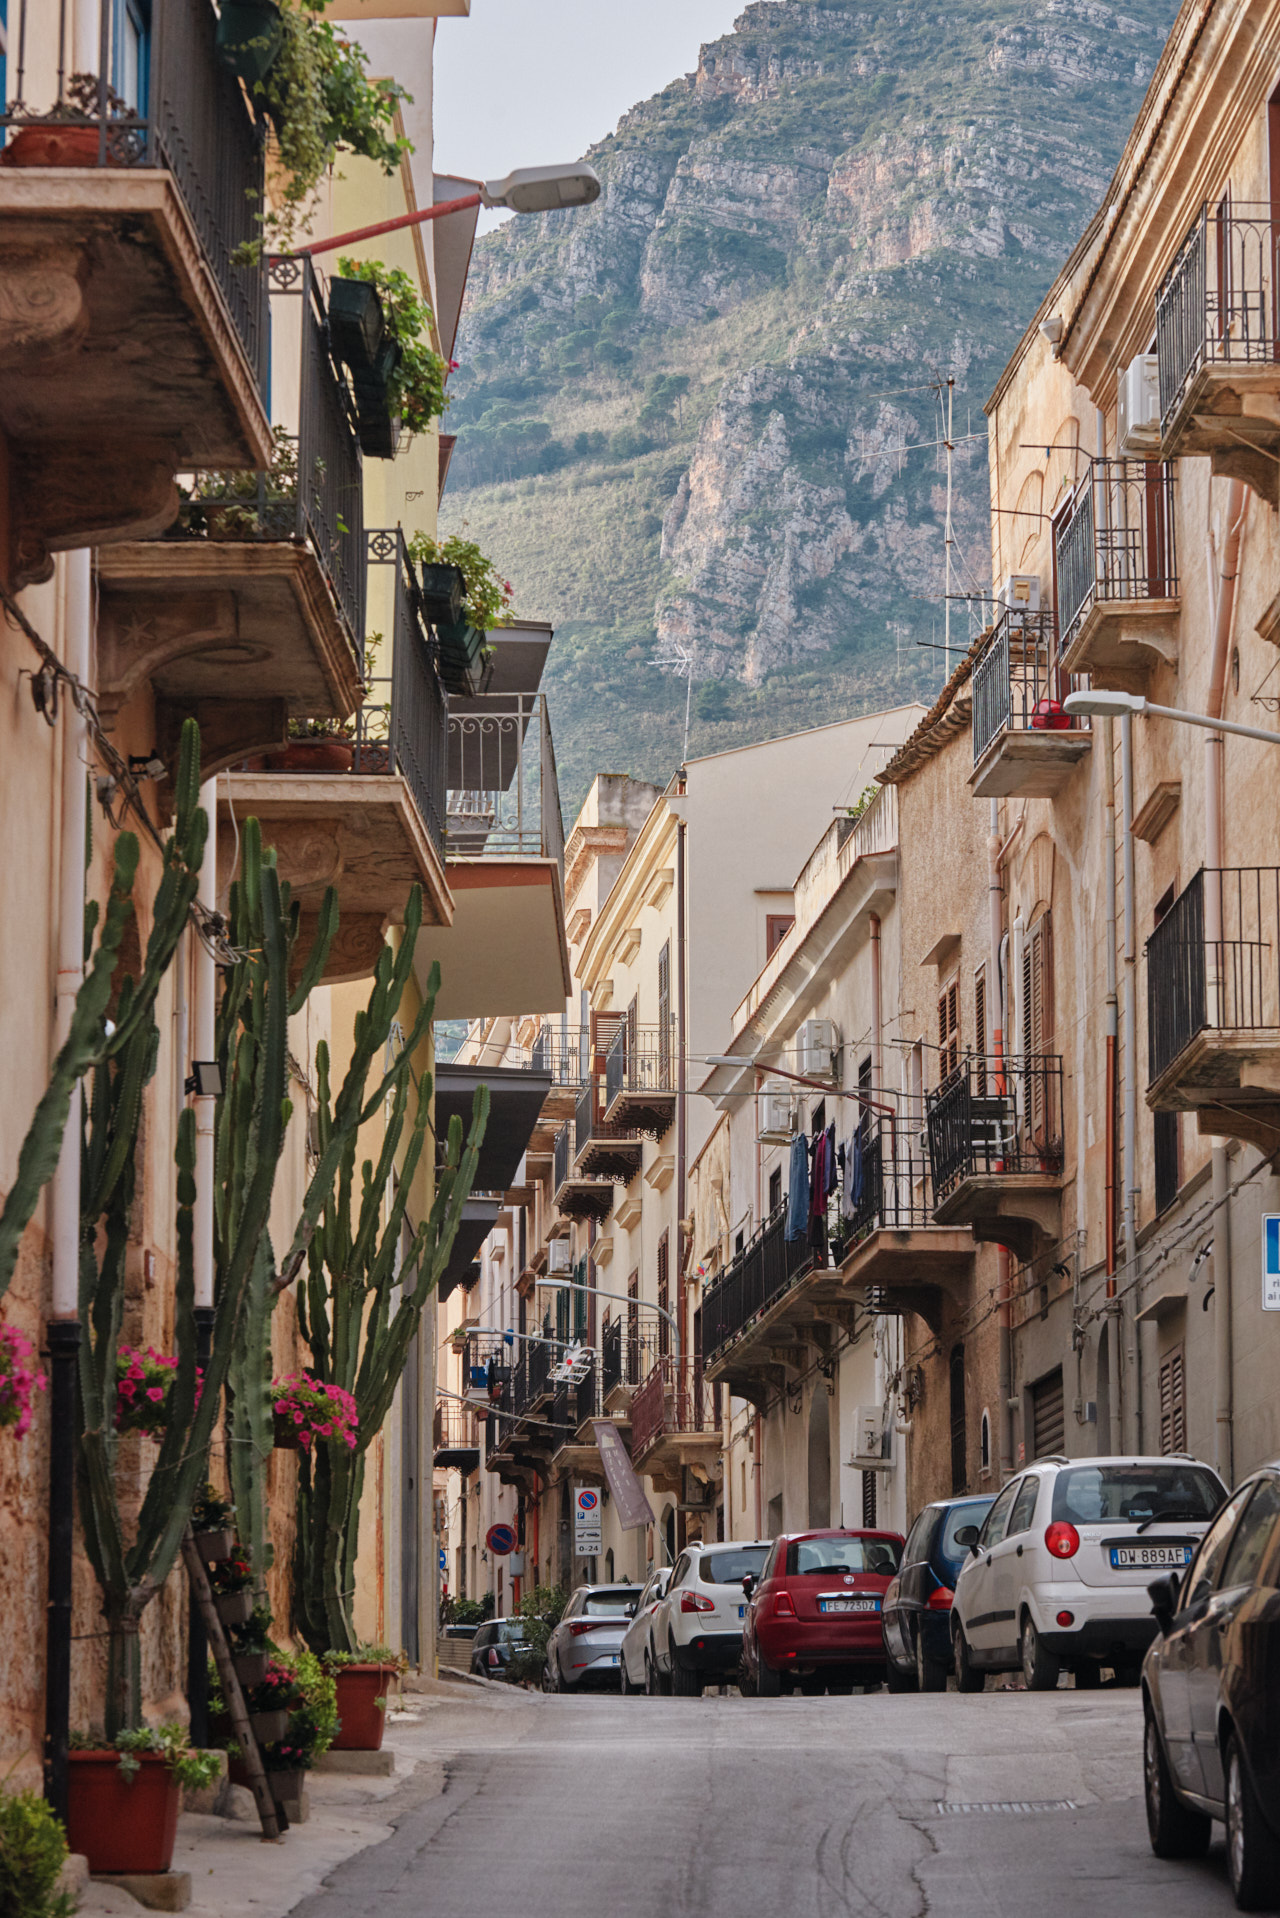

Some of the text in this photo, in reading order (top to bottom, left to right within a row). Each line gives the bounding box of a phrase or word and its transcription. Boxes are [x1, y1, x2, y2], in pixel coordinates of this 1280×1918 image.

[1272, 1278, 1280, 1288] ri
[1267, 1291, 1277, 1301] ai
[1120, 1550, 1136, 1564] DW
[1141, 1549, 1182, 1563] 889AF
[827, 1601, 875, 1611] FE 723DZ
